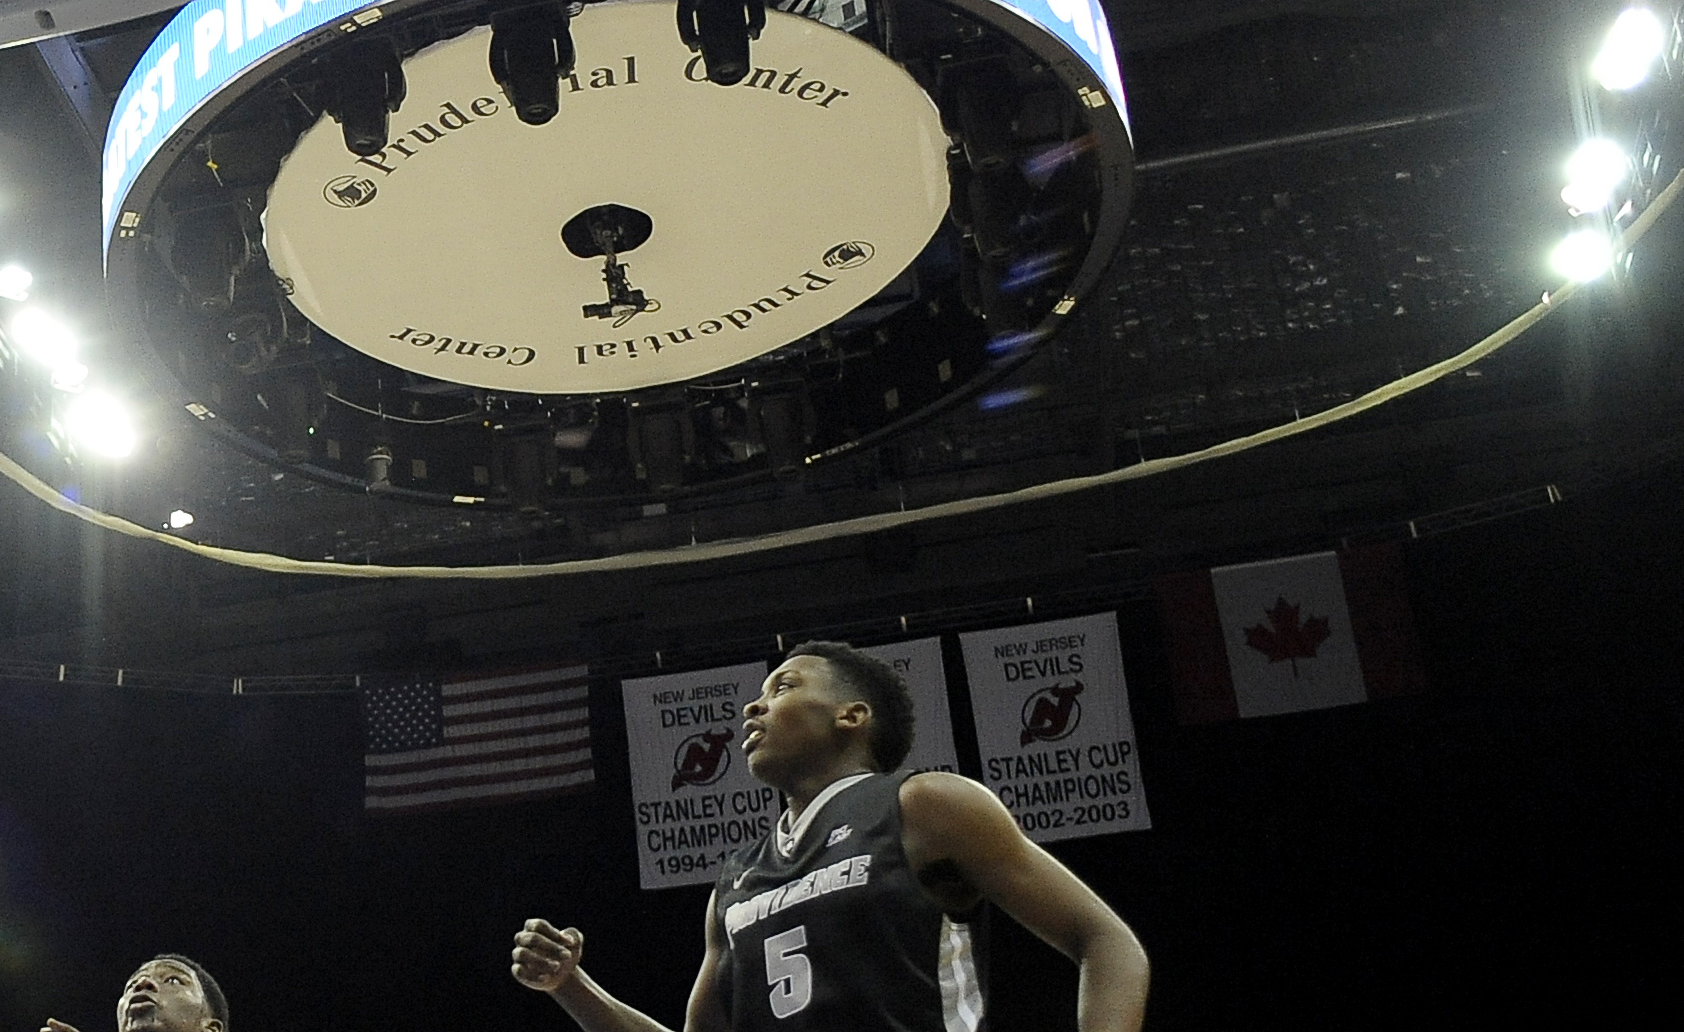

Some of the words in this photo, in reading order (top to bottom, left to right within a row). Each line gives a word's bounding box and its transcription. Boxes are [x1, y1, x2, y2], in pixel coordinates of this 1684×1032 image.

[355, 55, 640, 177] Prudeial
[683, 54, 850, 110] Cnter
[575, 269, 838, 367] Prudential
[388, 324, 538, 368] Center
[994, 645, 1029, 659] NEW
[1032, 633, 1087, 654] JERSEY
[1004, 653, 1084, 683] DEVILS
[652, 688, 686, 707] NEW
[687, 682, 740, 702] JERSEY
[660, 700, 736, 729] DEVILS
[987, 747, 1082, 782] STANLEY
[1087, 740, 1132, 769] CUP
[637, 792, 726, 825] STANLEY
[732, 786, 774, 815] CUP
[998, 770, 1132, 811] CHAMPIONS
[646, 817, 770, 854] CHAMPIONS
[763, 924, 813, 1020] 5
